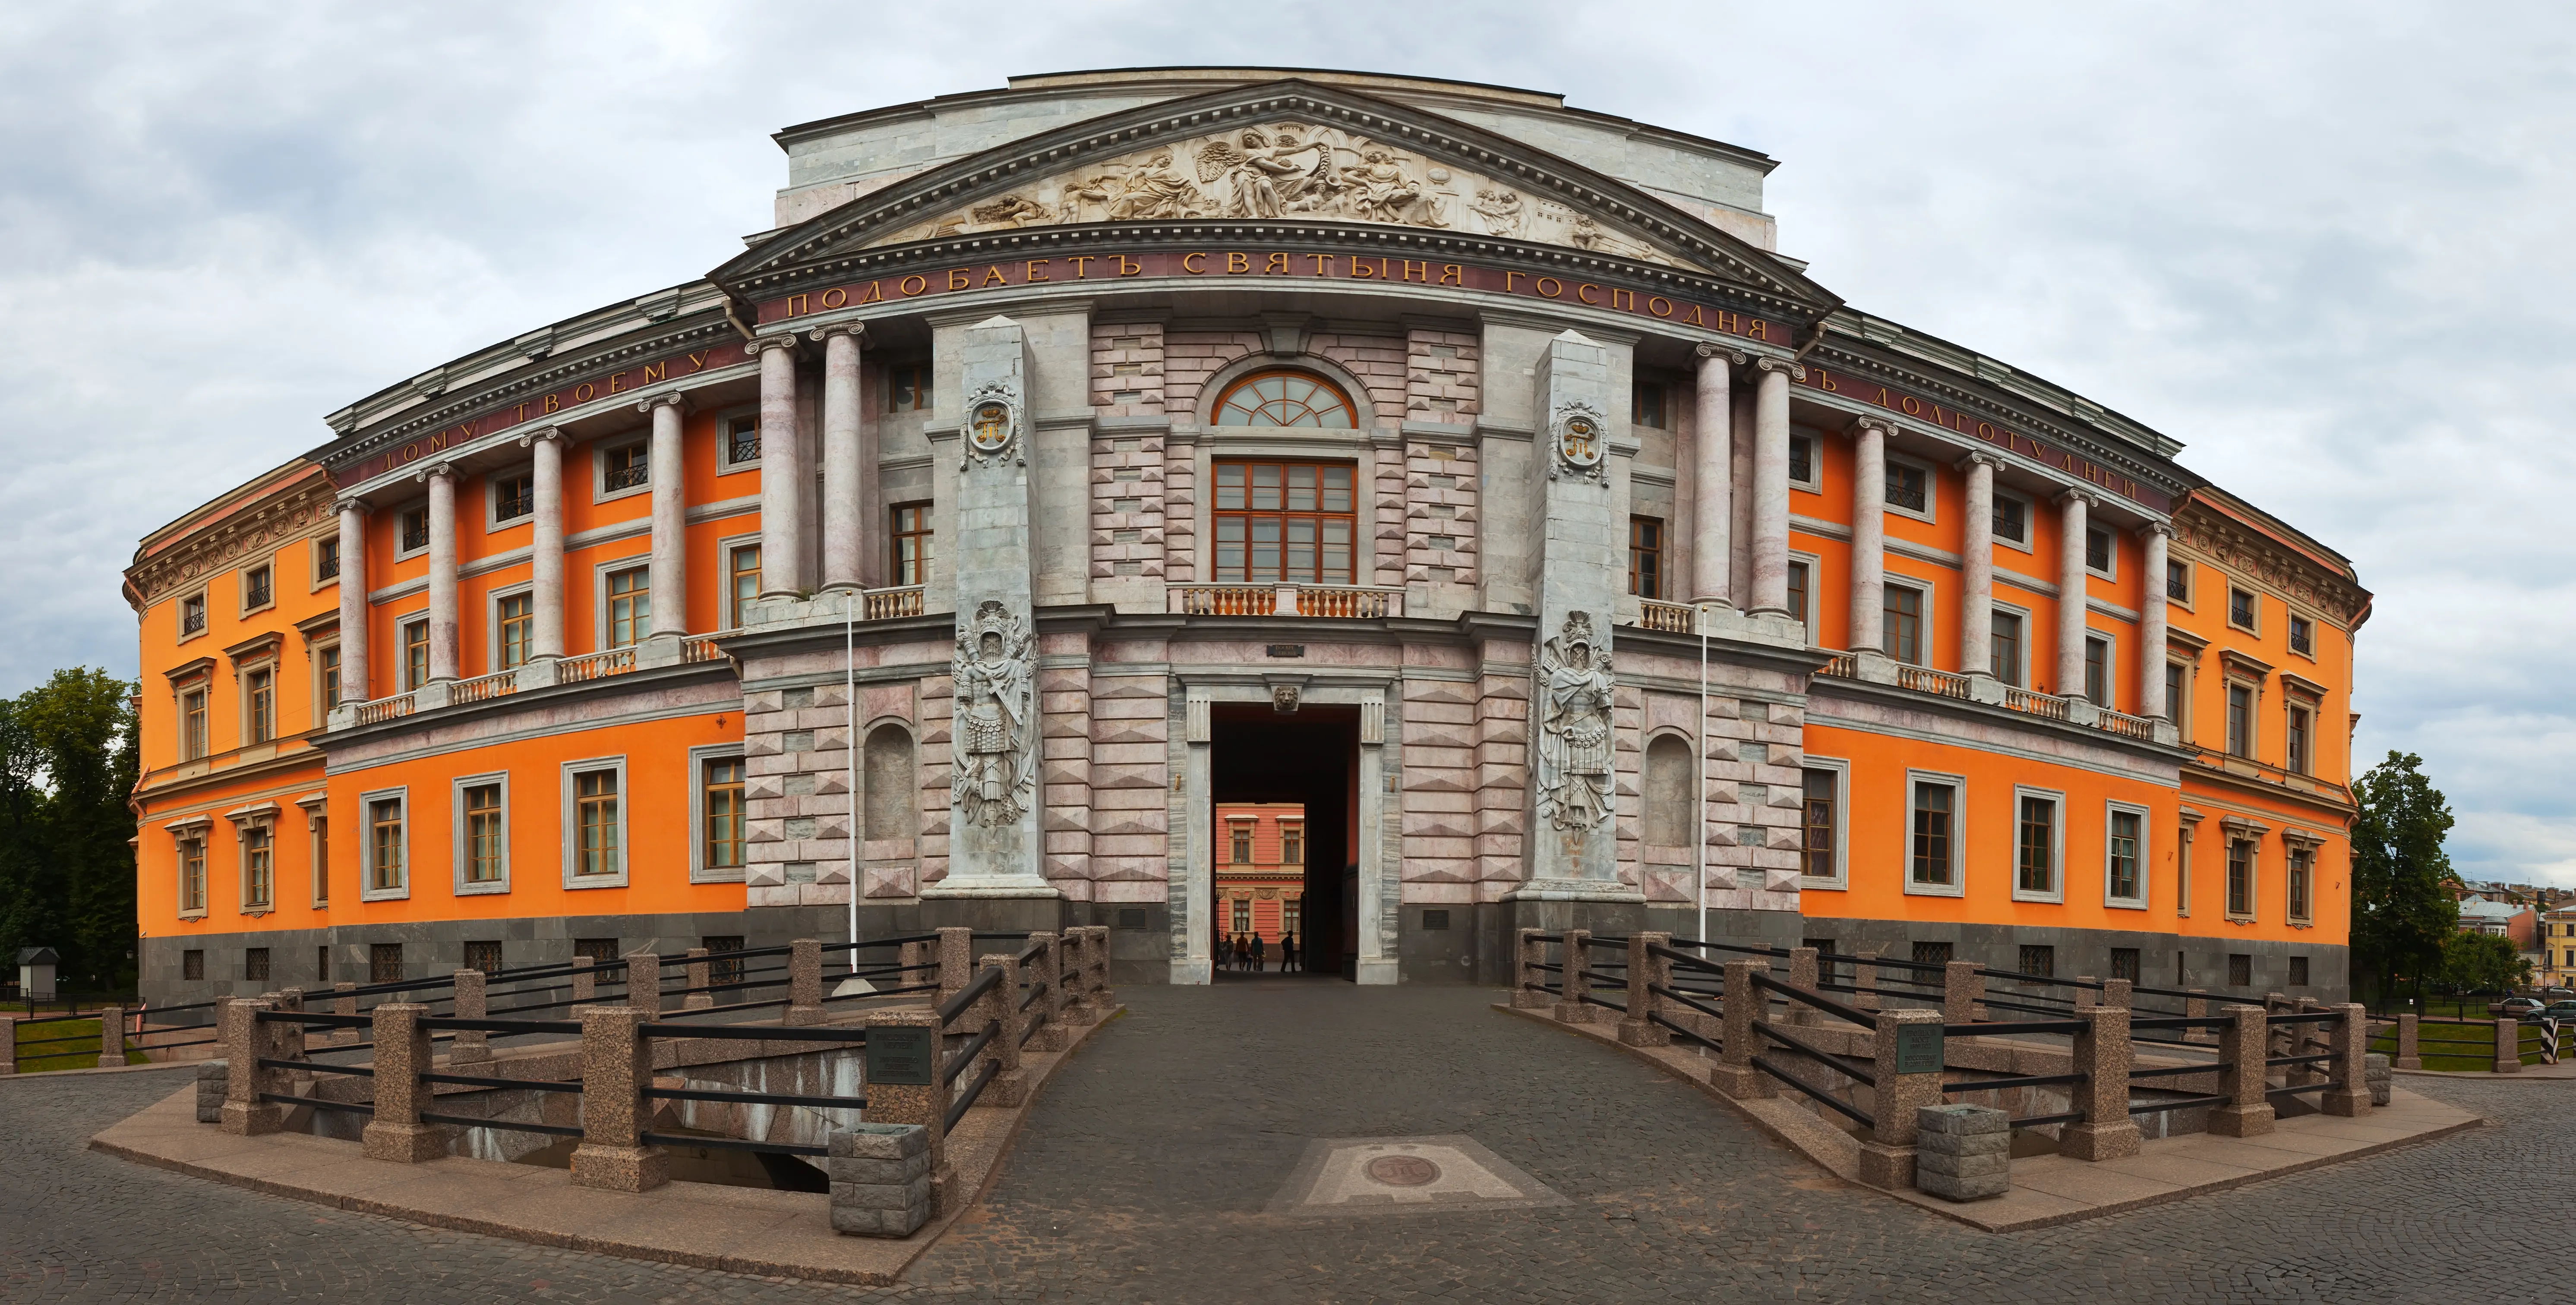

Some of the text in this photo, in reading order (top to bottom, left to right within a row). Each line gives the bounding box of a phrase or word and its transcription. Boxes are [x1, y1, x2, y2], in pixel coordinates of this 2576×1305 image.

[787, 252, 1766, 340] ПОДОБАЕТЪ СВЯТЫНЯ ГОСПОДНЯ
[380, 350, 709, 473] ДОМУ ТВОЕМУ
[1872, 388, 2047, 458] ДОЛГОТУ
[876, 1032, 921, 1040] РУССКИЙ
